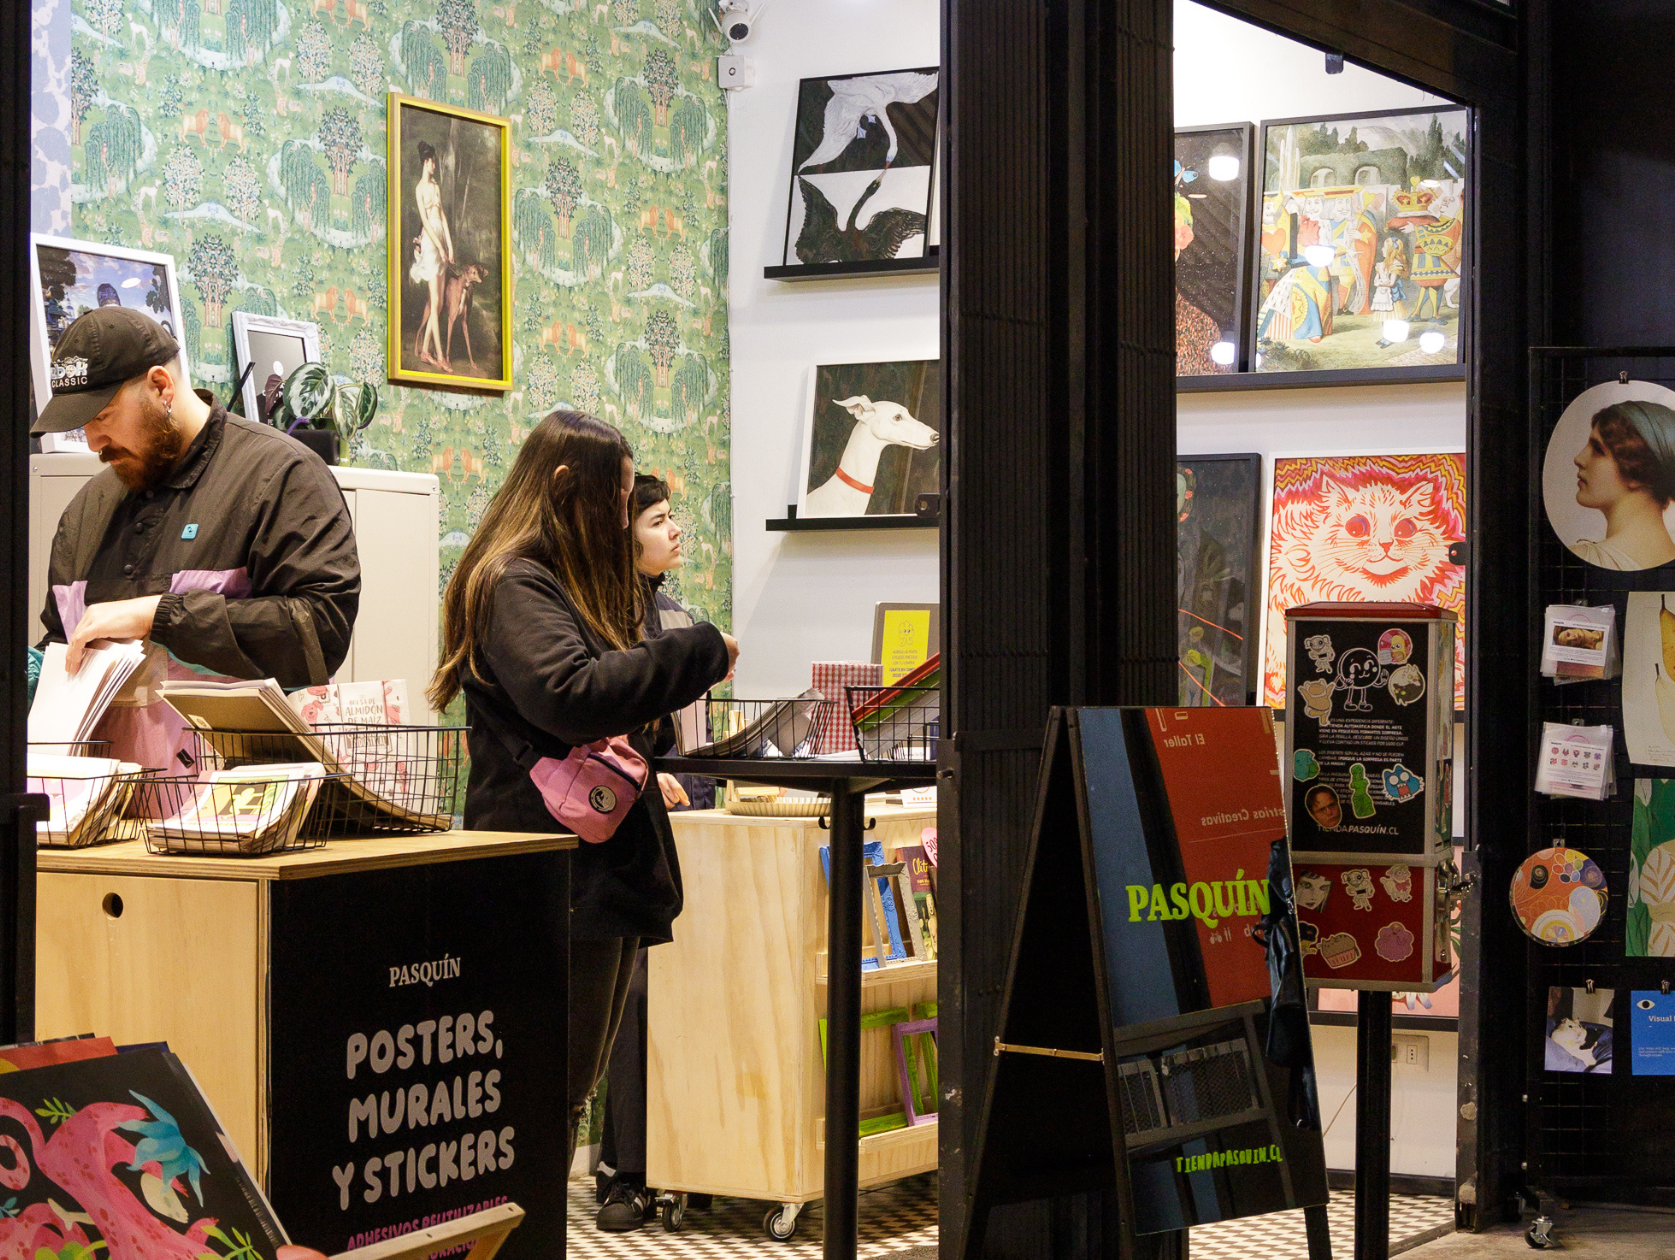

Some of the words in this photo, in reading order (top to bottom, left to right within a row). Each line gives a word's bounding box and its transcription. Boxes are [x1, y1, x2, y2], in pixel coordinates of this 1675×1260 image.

[52, 376, 88, 388] CLASSIC
[1126, 868, 1271, 929] PASQUÍN
[389, 953, 461, 987] PASQUÍN
[346, 1010, 503, 1080] POSTERS,
[348, 1068, 502, 1143] MURALES
[332, 1161, 355, 1211] Y
[363, 1126, 515, 1204] STICKERS
